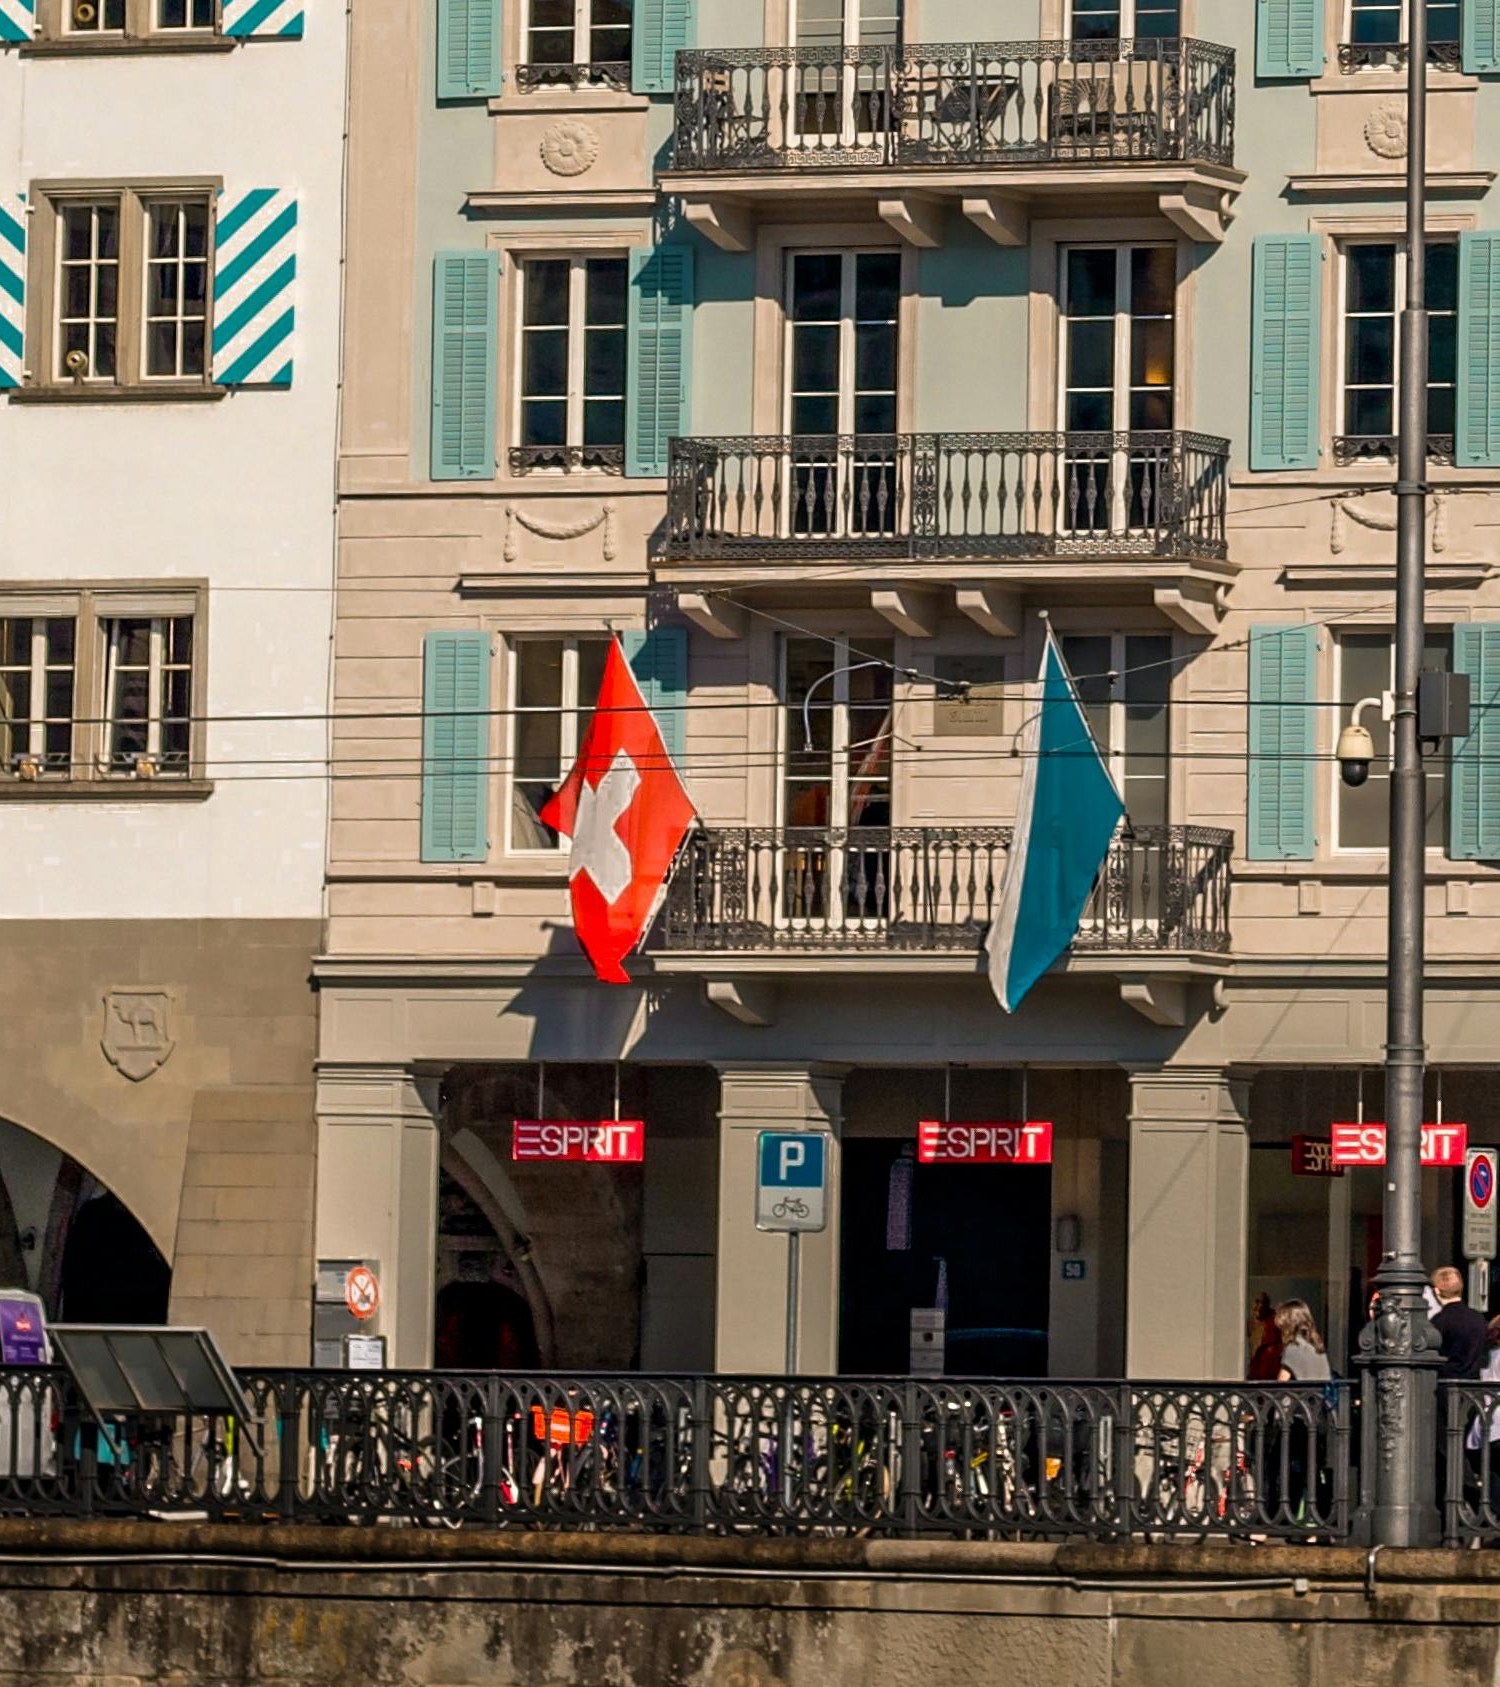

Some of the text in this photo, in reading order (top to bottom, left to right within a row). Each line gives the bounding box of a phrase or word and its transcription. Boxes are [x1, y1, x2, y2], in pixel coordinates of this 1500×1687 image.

[518, 1125, 636, 1156] ESPRIT
[924, 1127, 1044, 1158] ESPRIT
[1336, 1128, 1459, 1161] ESRIT
[779, 1140, 805, 1181] P
